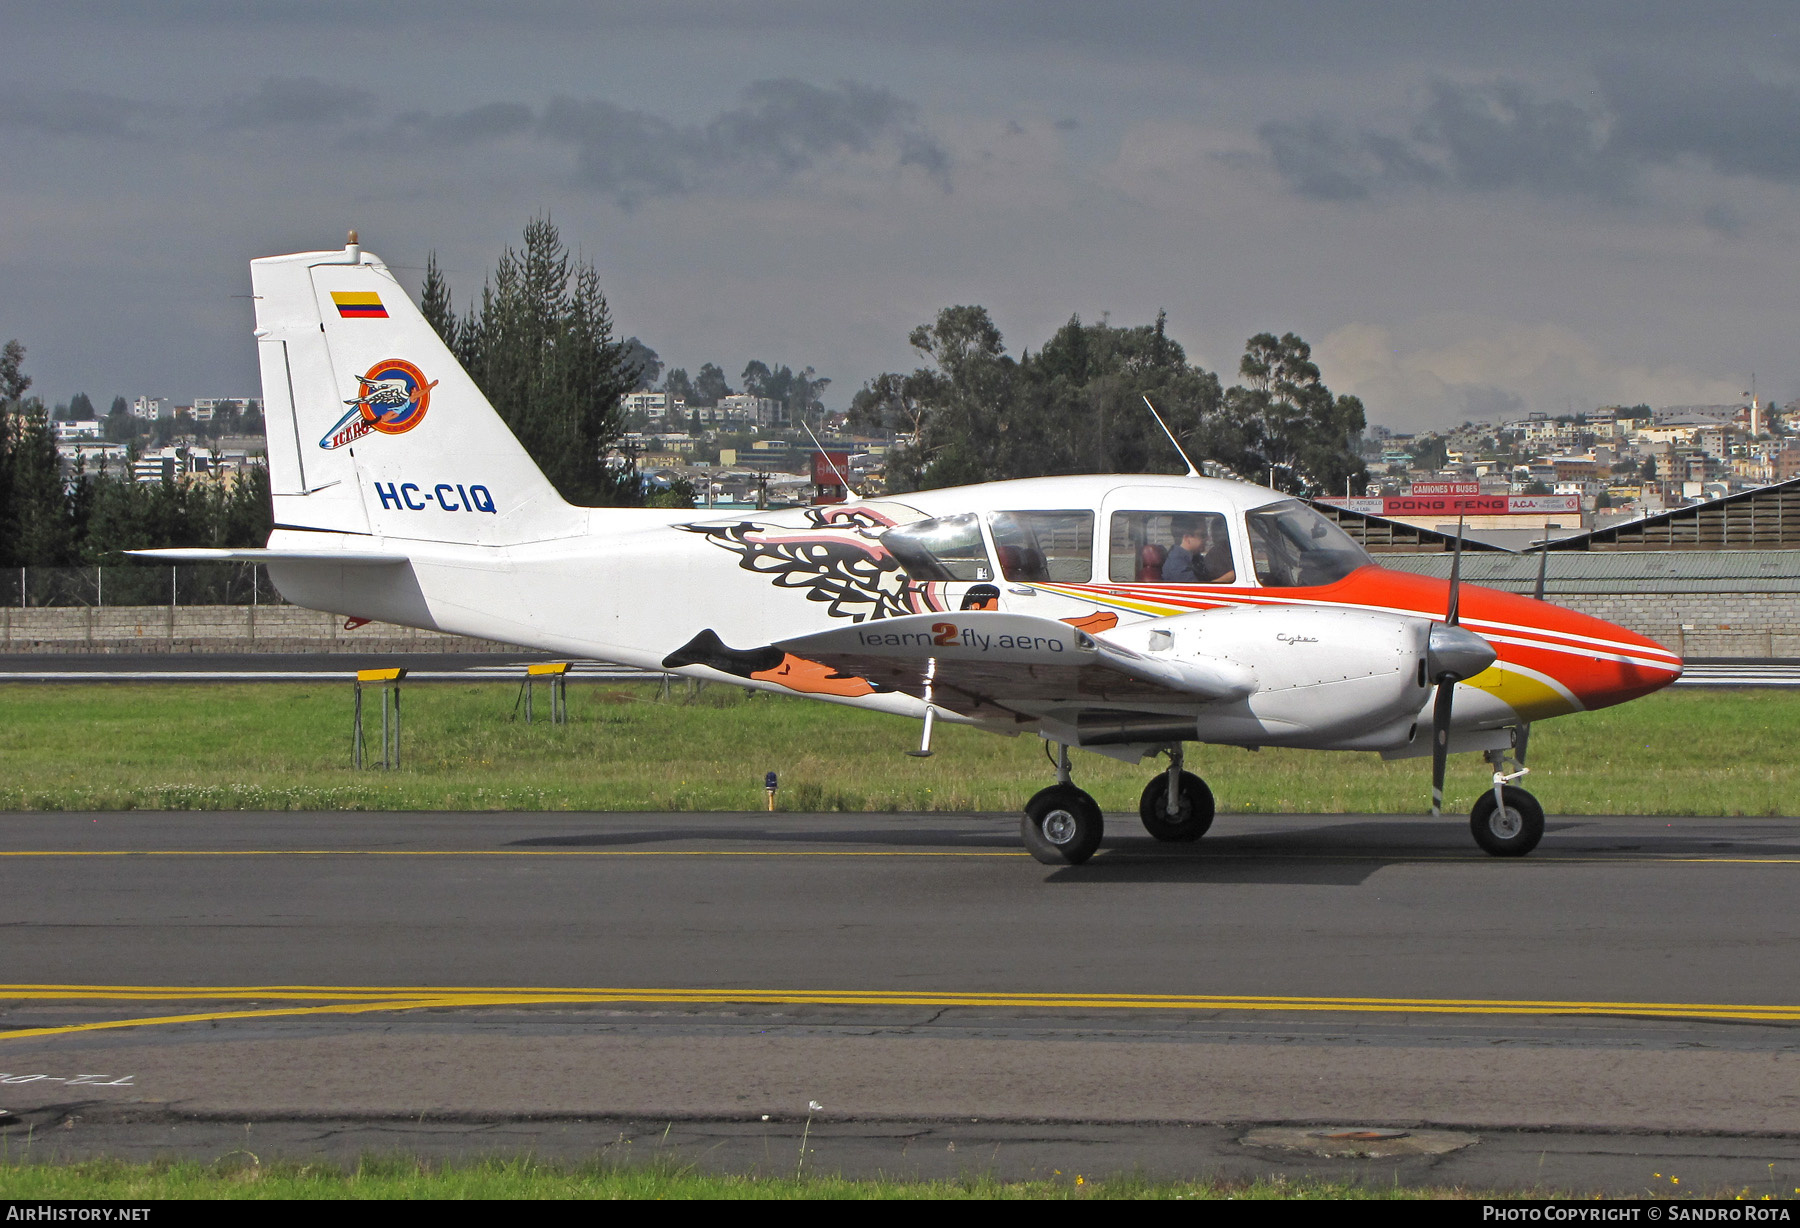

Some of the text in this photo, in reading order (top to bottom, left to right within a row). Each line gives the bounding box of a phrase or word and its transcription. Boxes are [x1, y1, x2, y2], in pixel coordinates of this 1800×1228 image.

[374, 481, 497, 514] HC-CIQ
[1413, 484, 1478, 494] CAMIONES Y BUSES
[1388, 500, 1504, 510] DONG FENG
[858, 622, 1064, 652] learn2fly.aero
